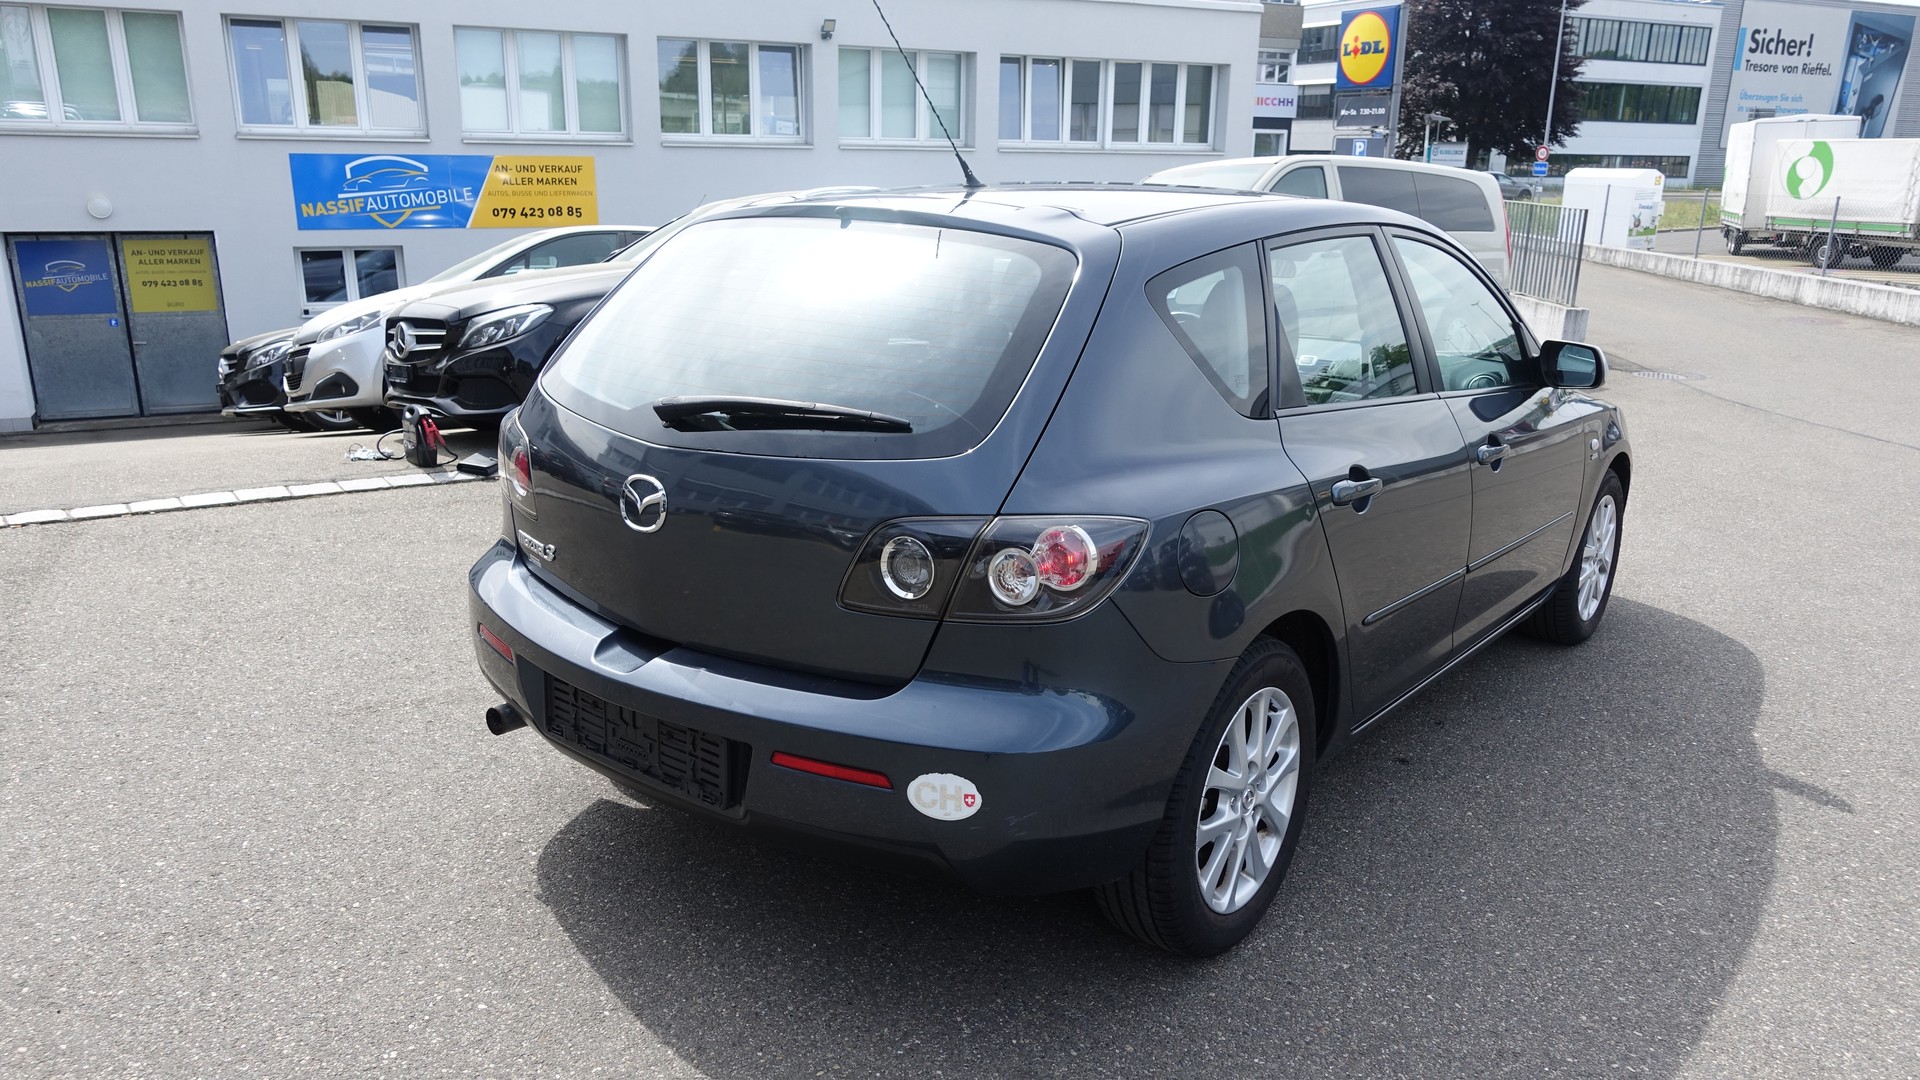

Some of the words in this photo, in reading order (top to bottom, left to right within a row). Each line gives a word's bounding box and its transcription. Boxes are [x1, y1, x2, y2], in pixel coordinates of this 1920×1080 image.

[1748, 28, 1814, 57] Sicher!
[1745, 59, 1778, 73] Tresore
[1782, 64, 1798, 74] von
[1801, 62, 1832, 76] Rieffel.
[1355, 141, 1364, 156] P
[495, 164, 513, 173] AN-
[516, 164, 536, 173] UND
[539, 164, 583, 173] VERKAUF
[503, 177, 534, 186] ALLER
[537, 177, 577, 186] MARKEN
[492, 207, 516, 218] 079
[520, 207, 544, 218] 423
[548, 206, 563, 217] 08
[567, 206, 582, 218] 85
[139, 258, 165, 266] ALLER
[142, 280, 158, 288] 079
[192, 279, 203, 287] 85
[914, 782, 962, 812] CH
